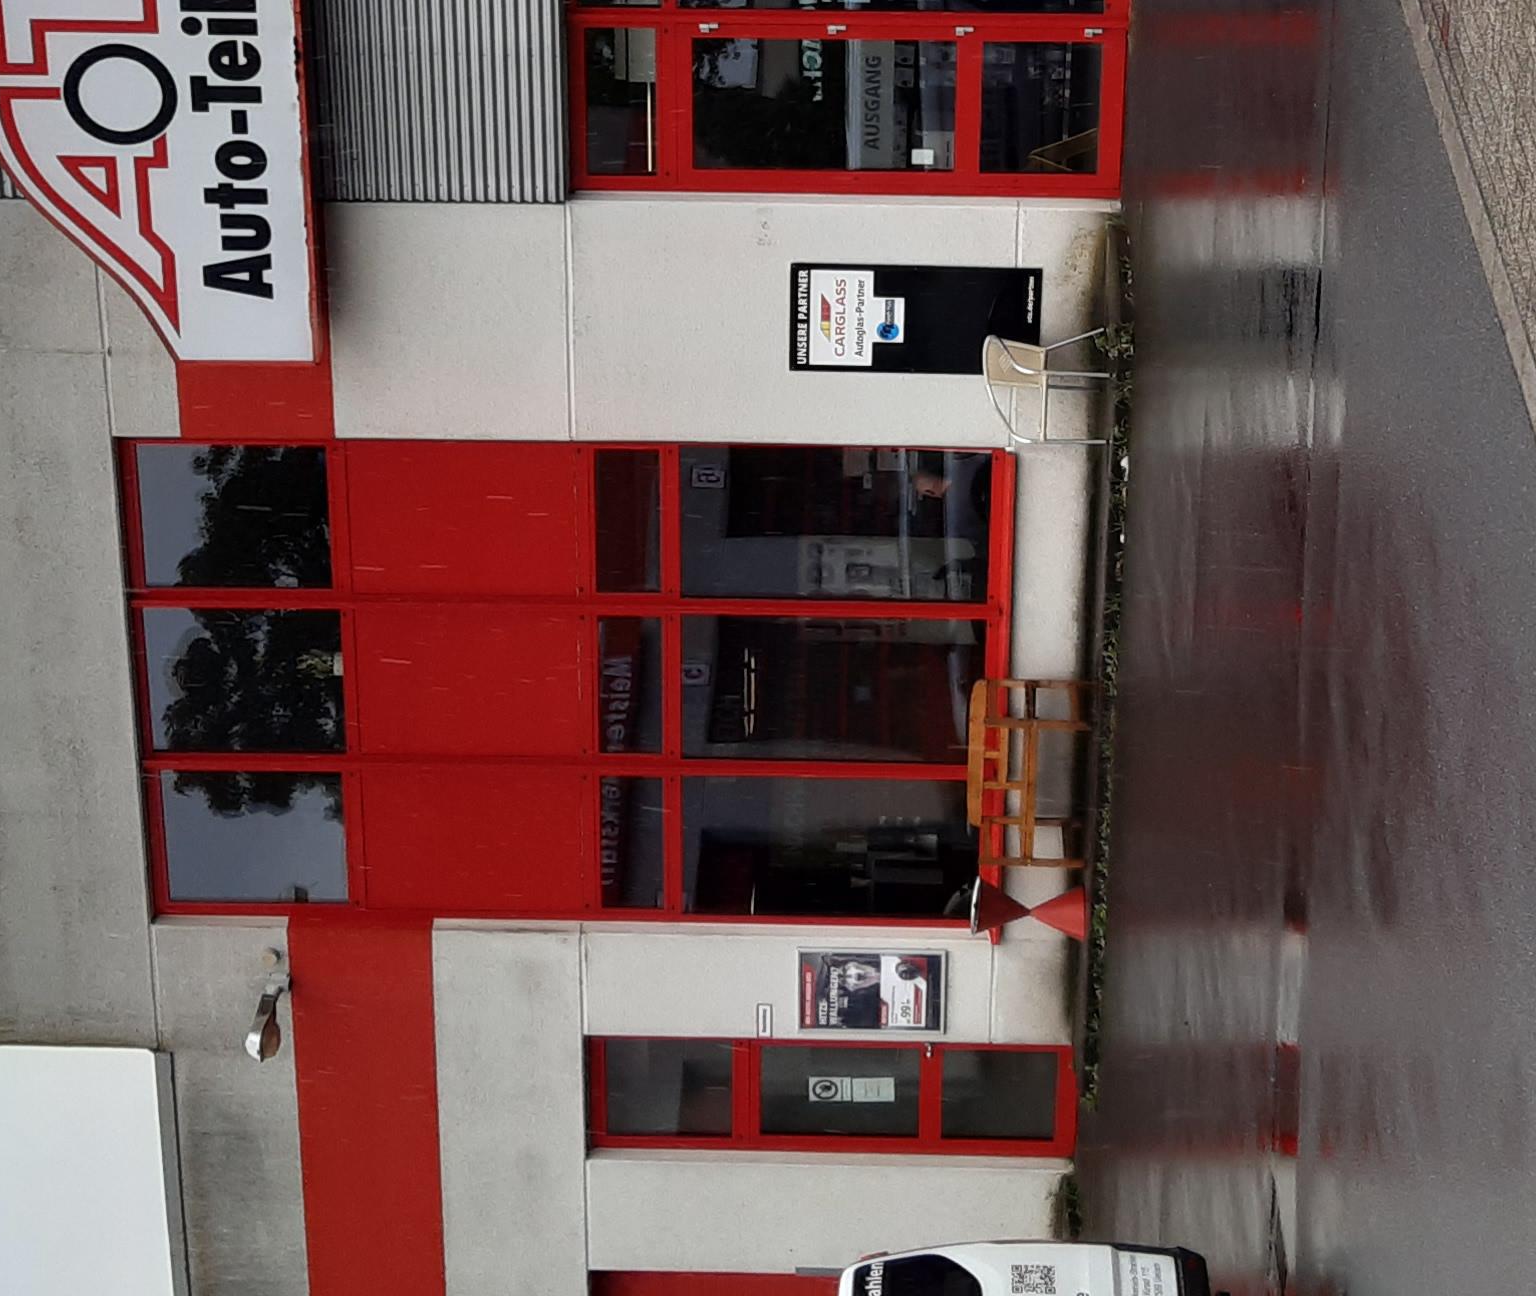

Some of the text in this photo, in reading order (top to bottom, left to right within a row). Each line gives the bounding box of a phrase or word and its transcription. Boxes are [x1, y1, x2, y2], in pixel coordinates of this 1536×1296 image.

[864, 56, 882, 150] AUSGANG
[796, 269, 809, 365] UNSERE PARTNER
[834, 279, 847, 357] CARGLASS
[854, 279, 866, 357] Autoglas-Partner
